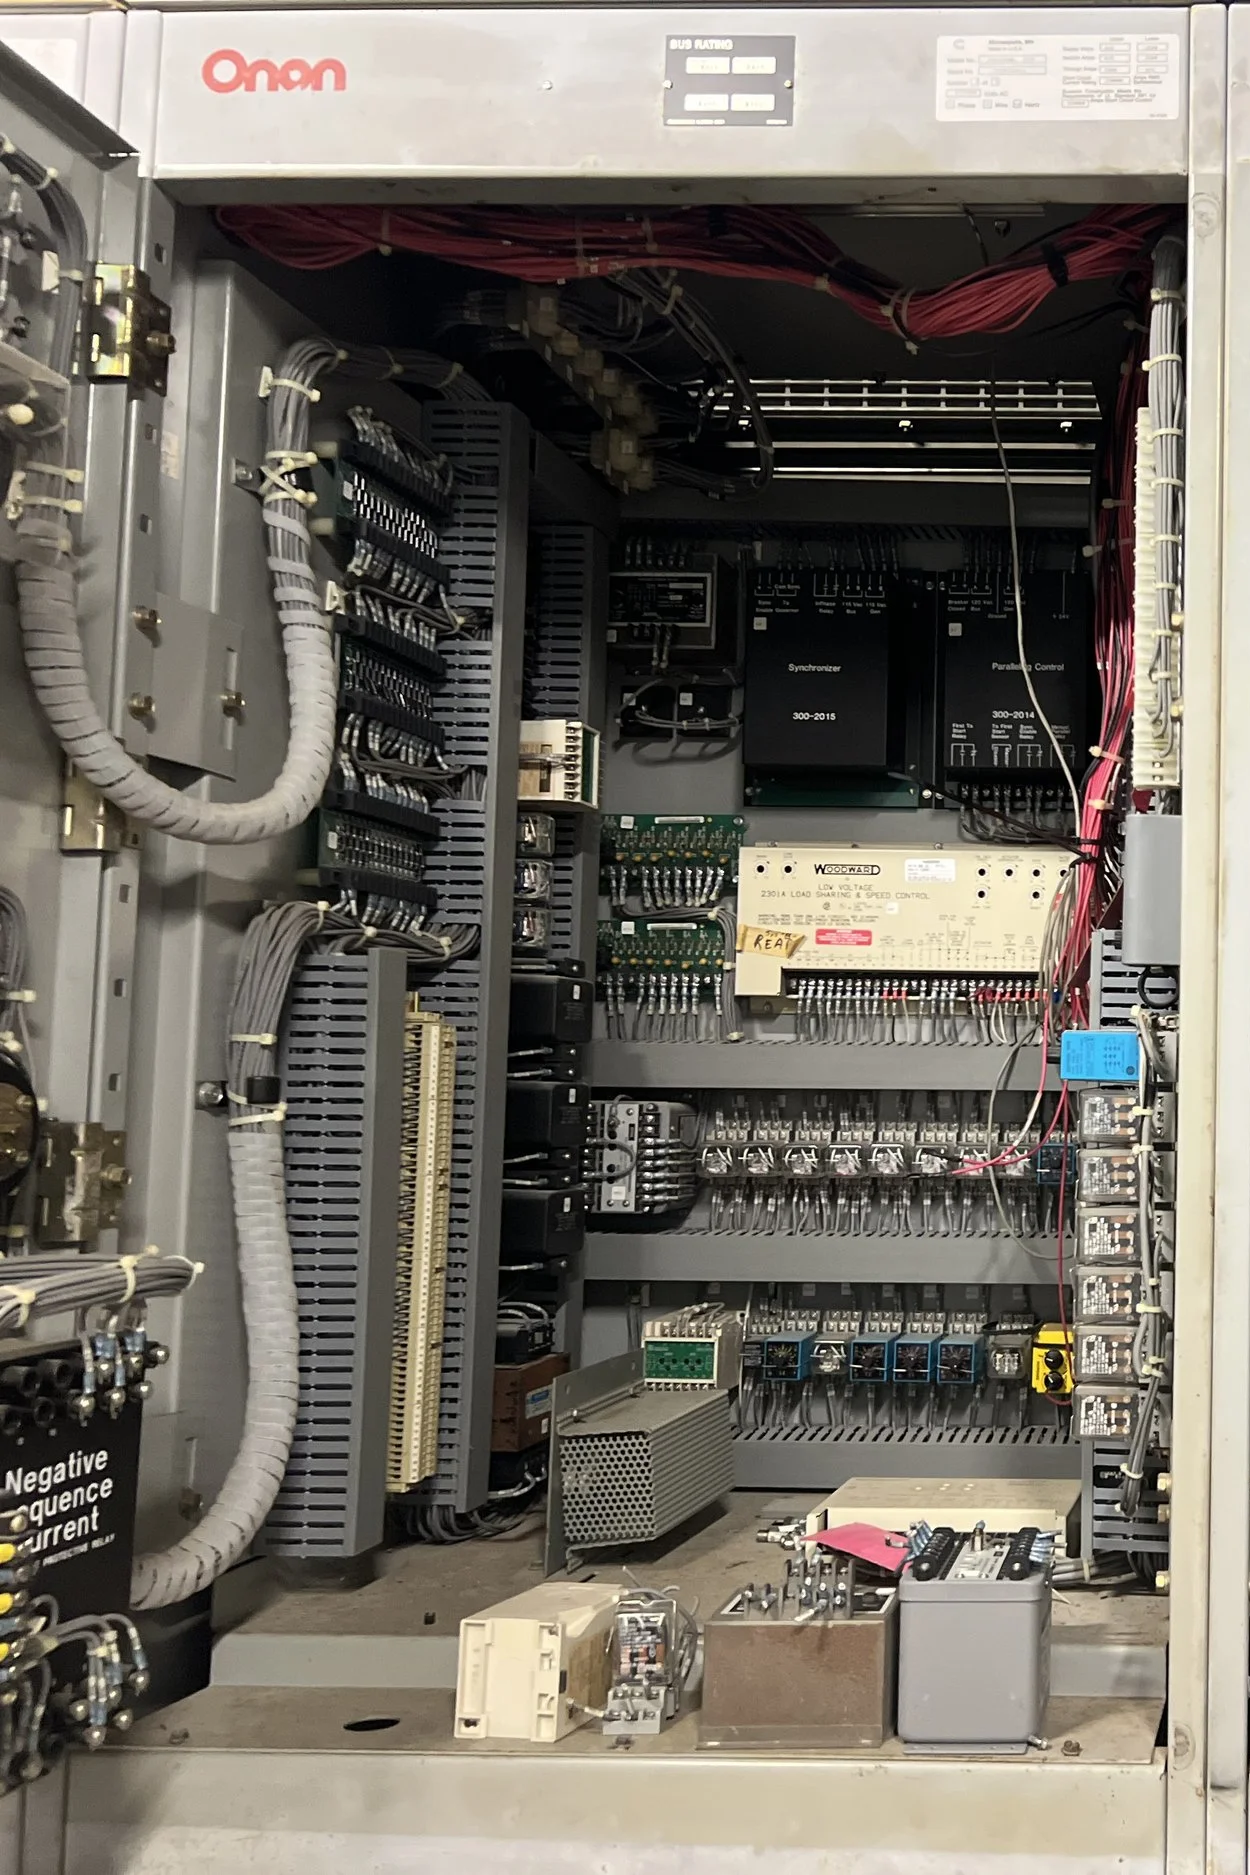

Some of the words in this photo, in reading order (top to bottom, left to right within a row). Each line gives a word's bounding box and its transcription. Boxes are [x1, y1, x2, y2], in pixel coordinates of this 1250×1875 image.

[669, 38, 692, 50] BUS
[694, 38, 733, 50] RATING
[202, 49, 346, 93] Onan
[788, 663, 842, 673] Synchronizer
[1034, 662, 1065, 671] Control
[792, 712, 837, 721] 300-2015
[992, 710, 1035, 719] 300-2014
[814, 864, 881, 876] WOODWARD
[761, 890, 786, 898] 2301A
[791, 891, 812, 899] LOAD
[816, 891, 852, 899] SHARING
[866, 892, 891, 900] SPEED
[896, 893, 930, 901] CONTROL
[5, 1450, 109, 1495] Negative
